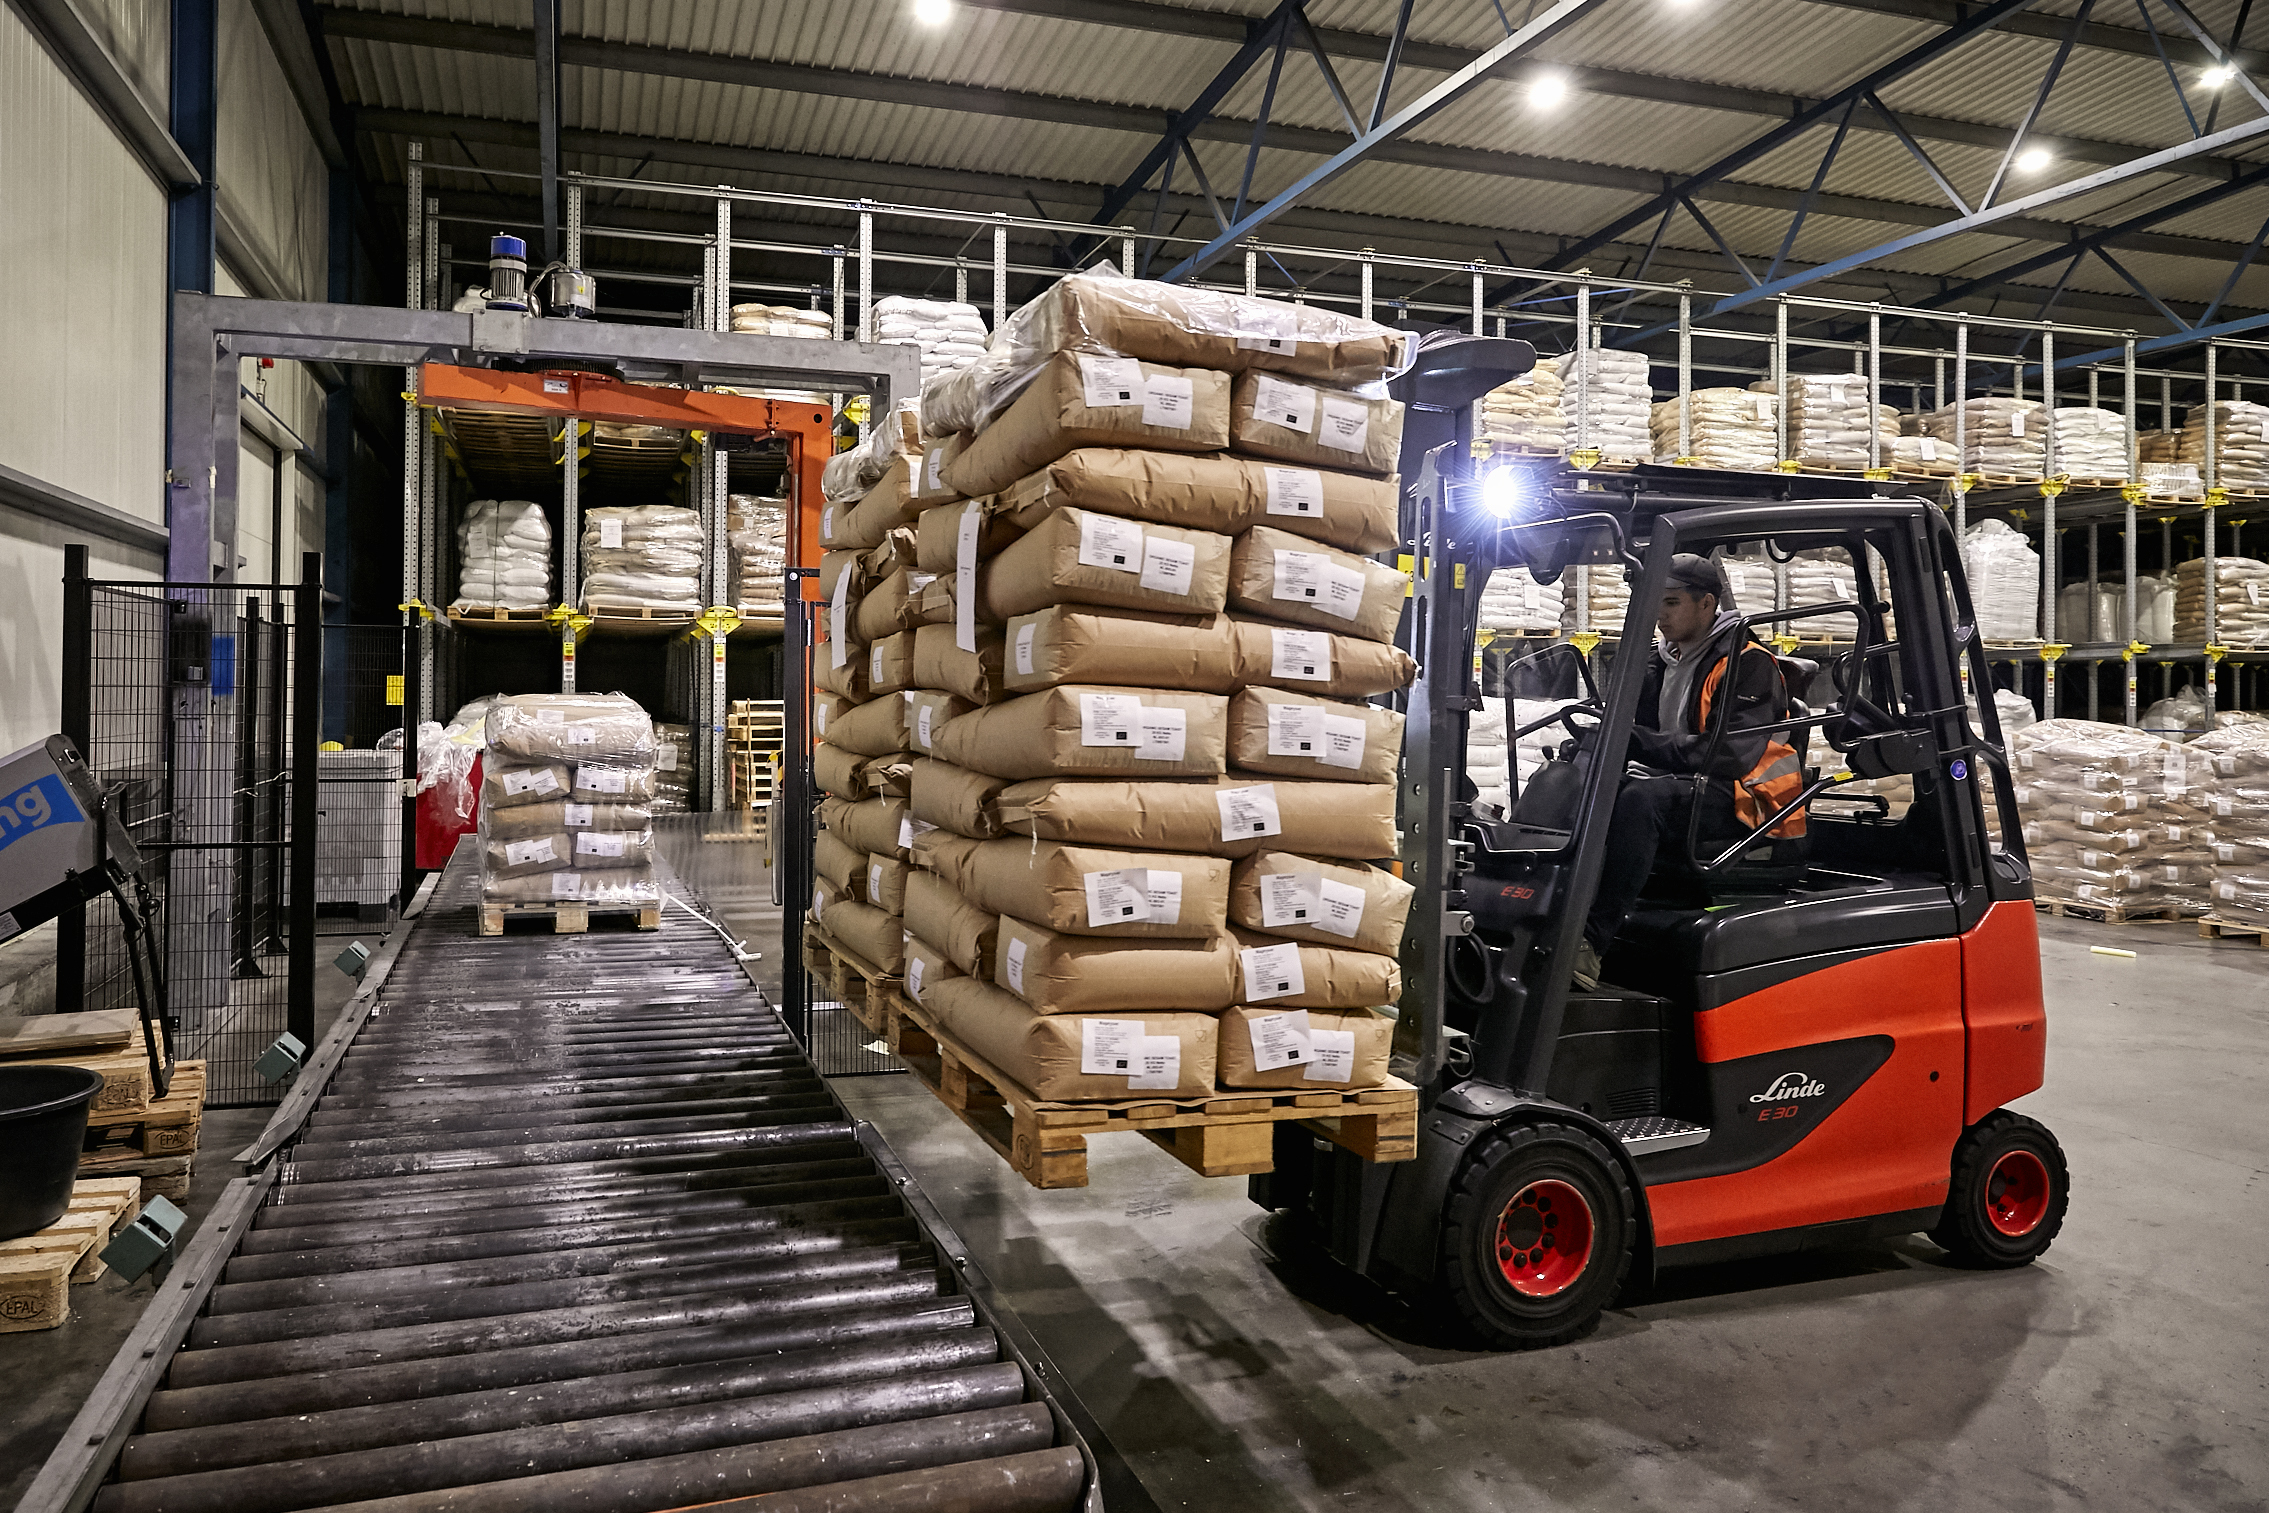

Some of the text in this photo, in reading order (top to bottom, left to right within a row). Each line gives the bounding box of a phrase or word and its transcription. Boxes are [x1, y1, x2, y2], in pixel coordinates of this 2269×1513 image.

[1749, 1072, 1825, 1103] Linde
[160, 1132, 183, 1146] EPAL
[6, 1301, 38, 1315] EPAL
